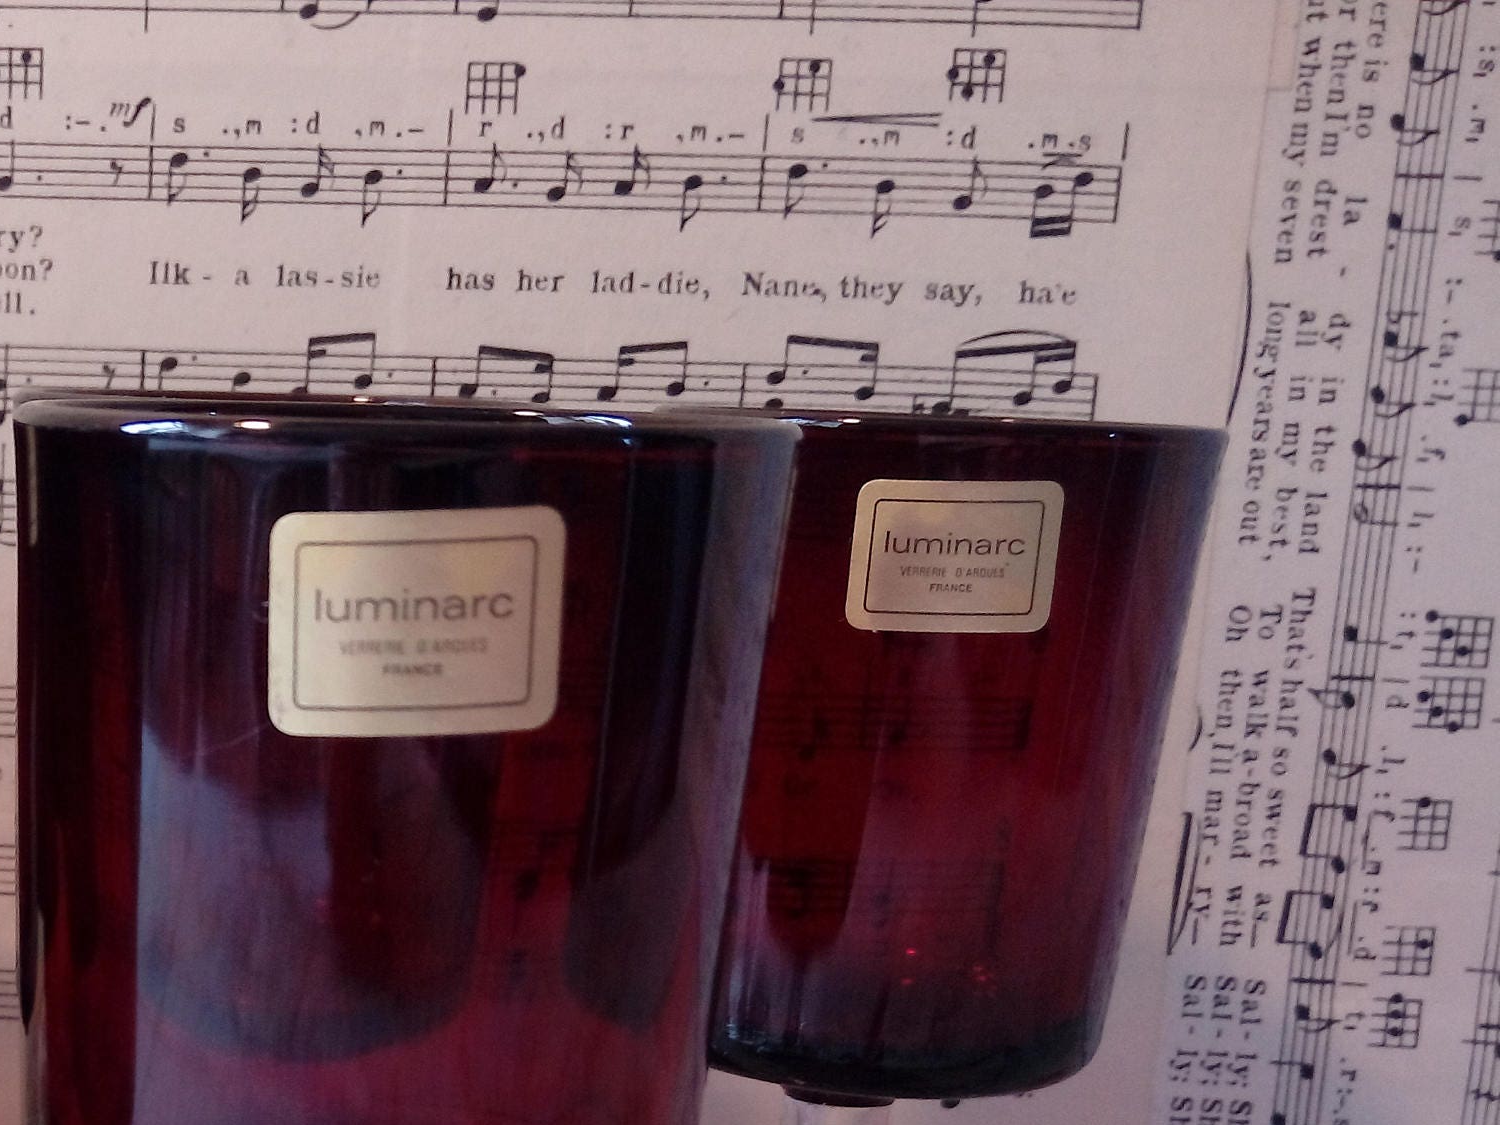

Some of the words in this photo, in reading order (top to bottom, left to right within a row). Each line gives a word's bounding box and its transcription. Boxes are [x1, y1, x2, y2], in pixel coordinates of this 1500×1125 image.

[1293, 36, 1322, 114] when
[1363, 59, 1388, 83] is
[1355, 104, 1375, 139] no
[1281, 122, 1309, 168] my
[1274, 179, 1301, 264] seven
[1307, 178, 1338, 259] drest
[446, 266, 495, 291] has
[516, 269, 564, 292] her
[840, 275, 904, 307] they
[924, 283, 983, 307] say,
[1255, 301, 1291, 363] long
[1295, 309, 1319, 347] all
[1251, 366, 1277, 442] years
[1288, 375, 1314, 402] in
[1318, 376, 1345, 403] in
[1275, 421, 1300, 467] my
[1310, 424, 1338, 473] the
[1245, 447, 1267, 491] are
[883, 529, 1027, 558] luminarc
[1238, 499, 1260, 545] out
[1298, 491, 1328, 553] land
[314, 586, 515, 626] luminarc
[928, 582, 974, 594] FRANCE
[1224, 604, 1252, 643] Oh
[1258, 603, 1283, 640] To
[1284, 586, 1316, 669] That's
[1243, 669, 1269, 739] walk
[1276, 679, 1304, 737] half
[1270, 746, 1289, 776] so
[1258, 788, 1283, 867] sweet
[1219, 885, 1243, 947] with
